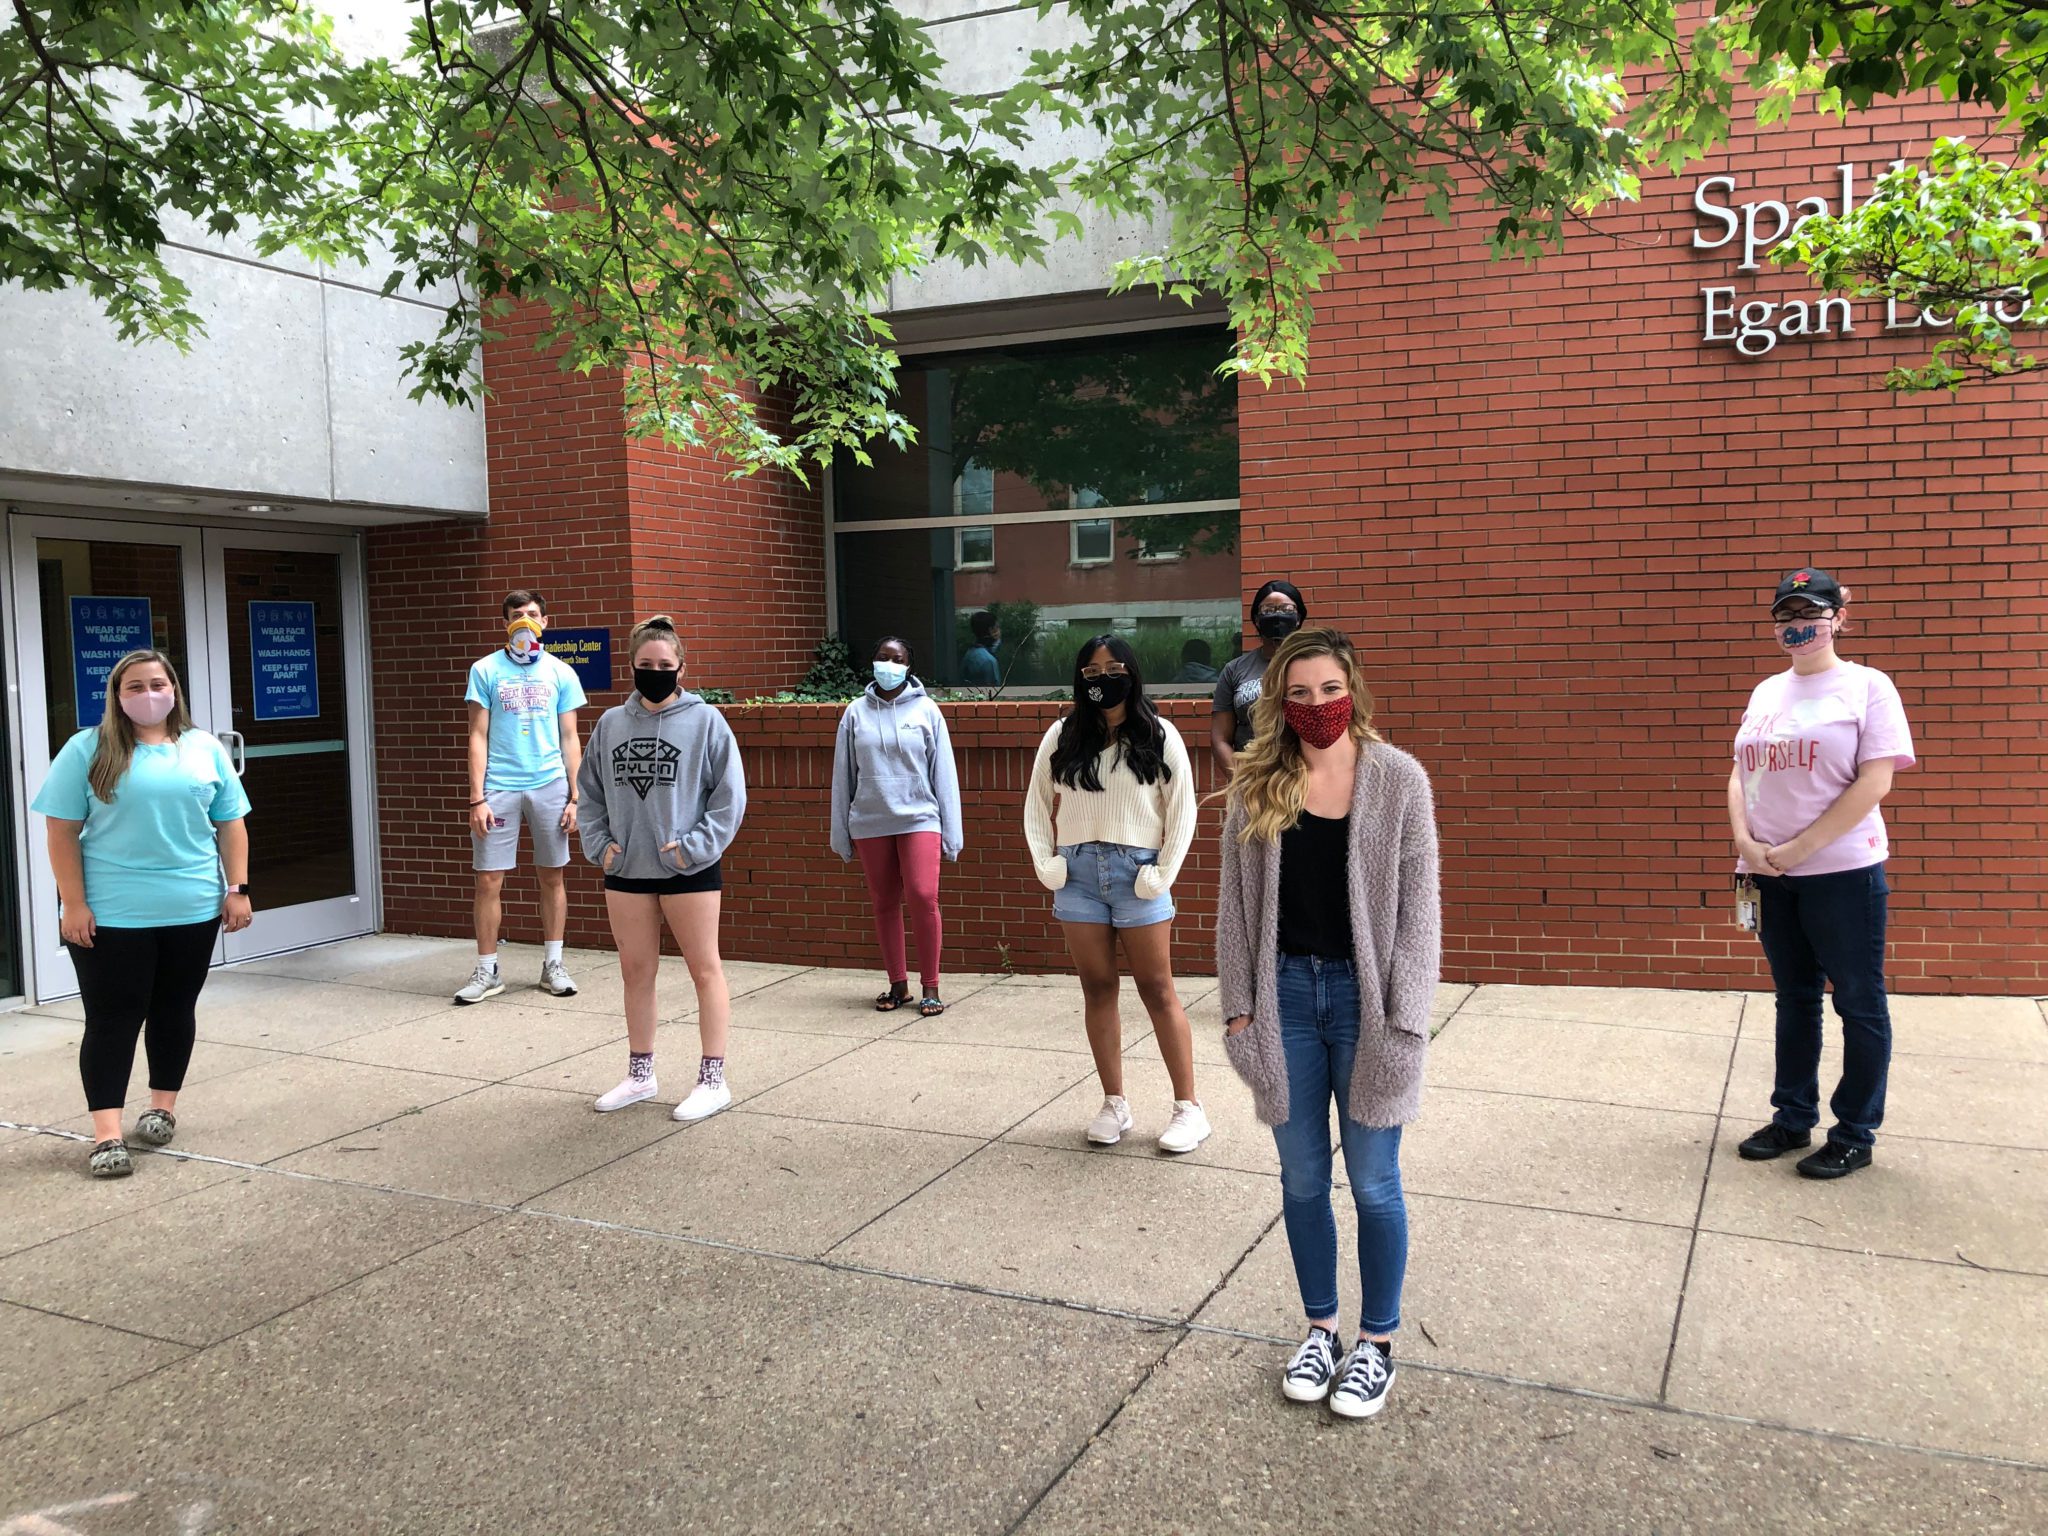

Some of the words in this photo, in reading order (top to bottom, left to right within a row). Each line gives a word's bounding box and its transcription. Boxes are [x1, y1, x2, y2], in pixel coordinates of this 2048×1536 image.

[1701, 286, 1856, 356] Egan
[85, 625, 115, 634] WEAR
[116, 625, 141, 634] FACE
[261, 627, 285, 636] WEAR
[286, 627, 306, 635] FACE
[99, 634, 128, 643] MASK
[272, 635, 296, 643] MASK
[545, 639, 578, 654] eadership
[579, 639, 602, 652] Center
[81, 650, 111, 659] WASH
[257, 649, 282, 657] WASH
[283, 649, 311, 657] HANDS
[575, 655, 590, 664] Street
[86, 666, 111, 675] KEEP
[262, 664, 282, 672] KEEP
[283, 663, 289, 671] 6
[290, 663, 309, 671] FEET
[273, 671, 299, 679] APART
[266, 686, 287, 694] STAY
[286, 685, 307, 693] SAFE
[499, 687, 519, 701] GREAT
[520, 685, 552, 698] AMERICAN
[503, 698, 531, 712] BALLOON
[1737, 738, 1820, 772] YOURSELF
